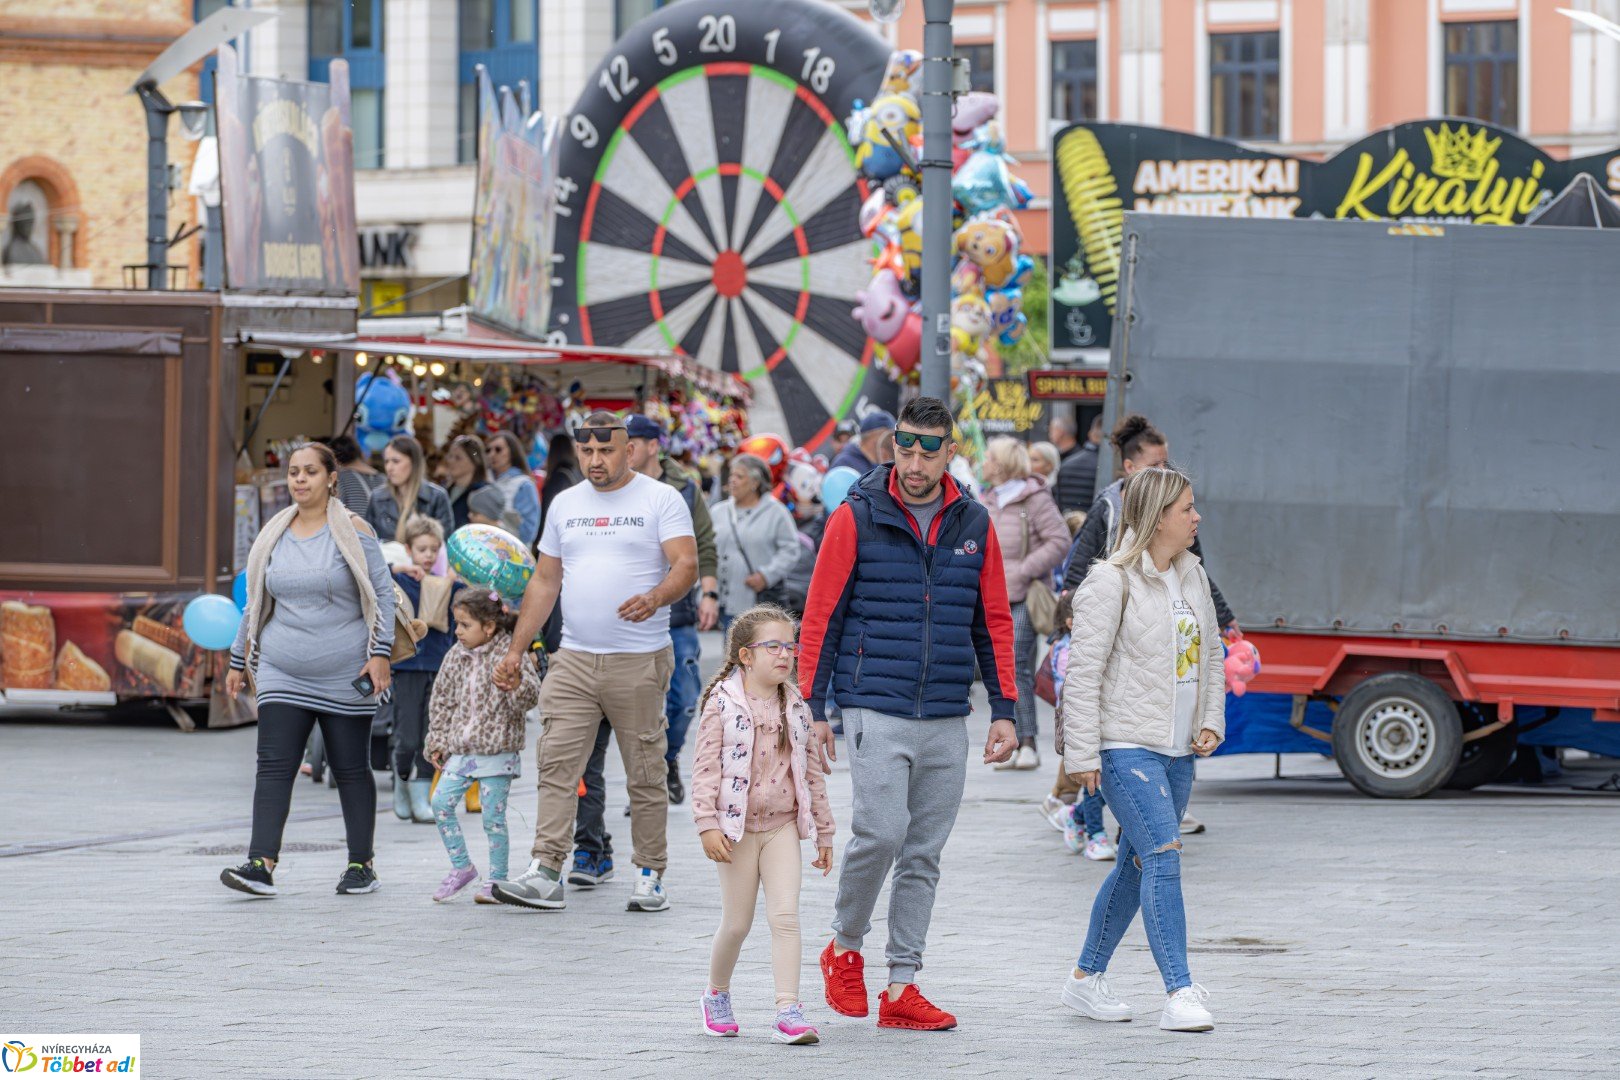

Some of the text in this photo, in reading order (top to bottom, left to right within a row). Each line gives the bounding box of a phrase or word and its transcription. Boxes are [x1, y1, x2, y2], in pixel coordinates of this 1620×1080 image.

[652, 27, 678, 66] 5
[698, 15, 736, 53] 20
[763, 29, 781, 64] 1
[599, 55, 639, 102] 12
[801, 47, 836, 94] 18
[570, 113, 599, 149] 9
[1133, 159, 1300, 194] AMERIKAI
[565, 517, 595, 529] RETRO
[609, 516, 645, 527] JEANS
